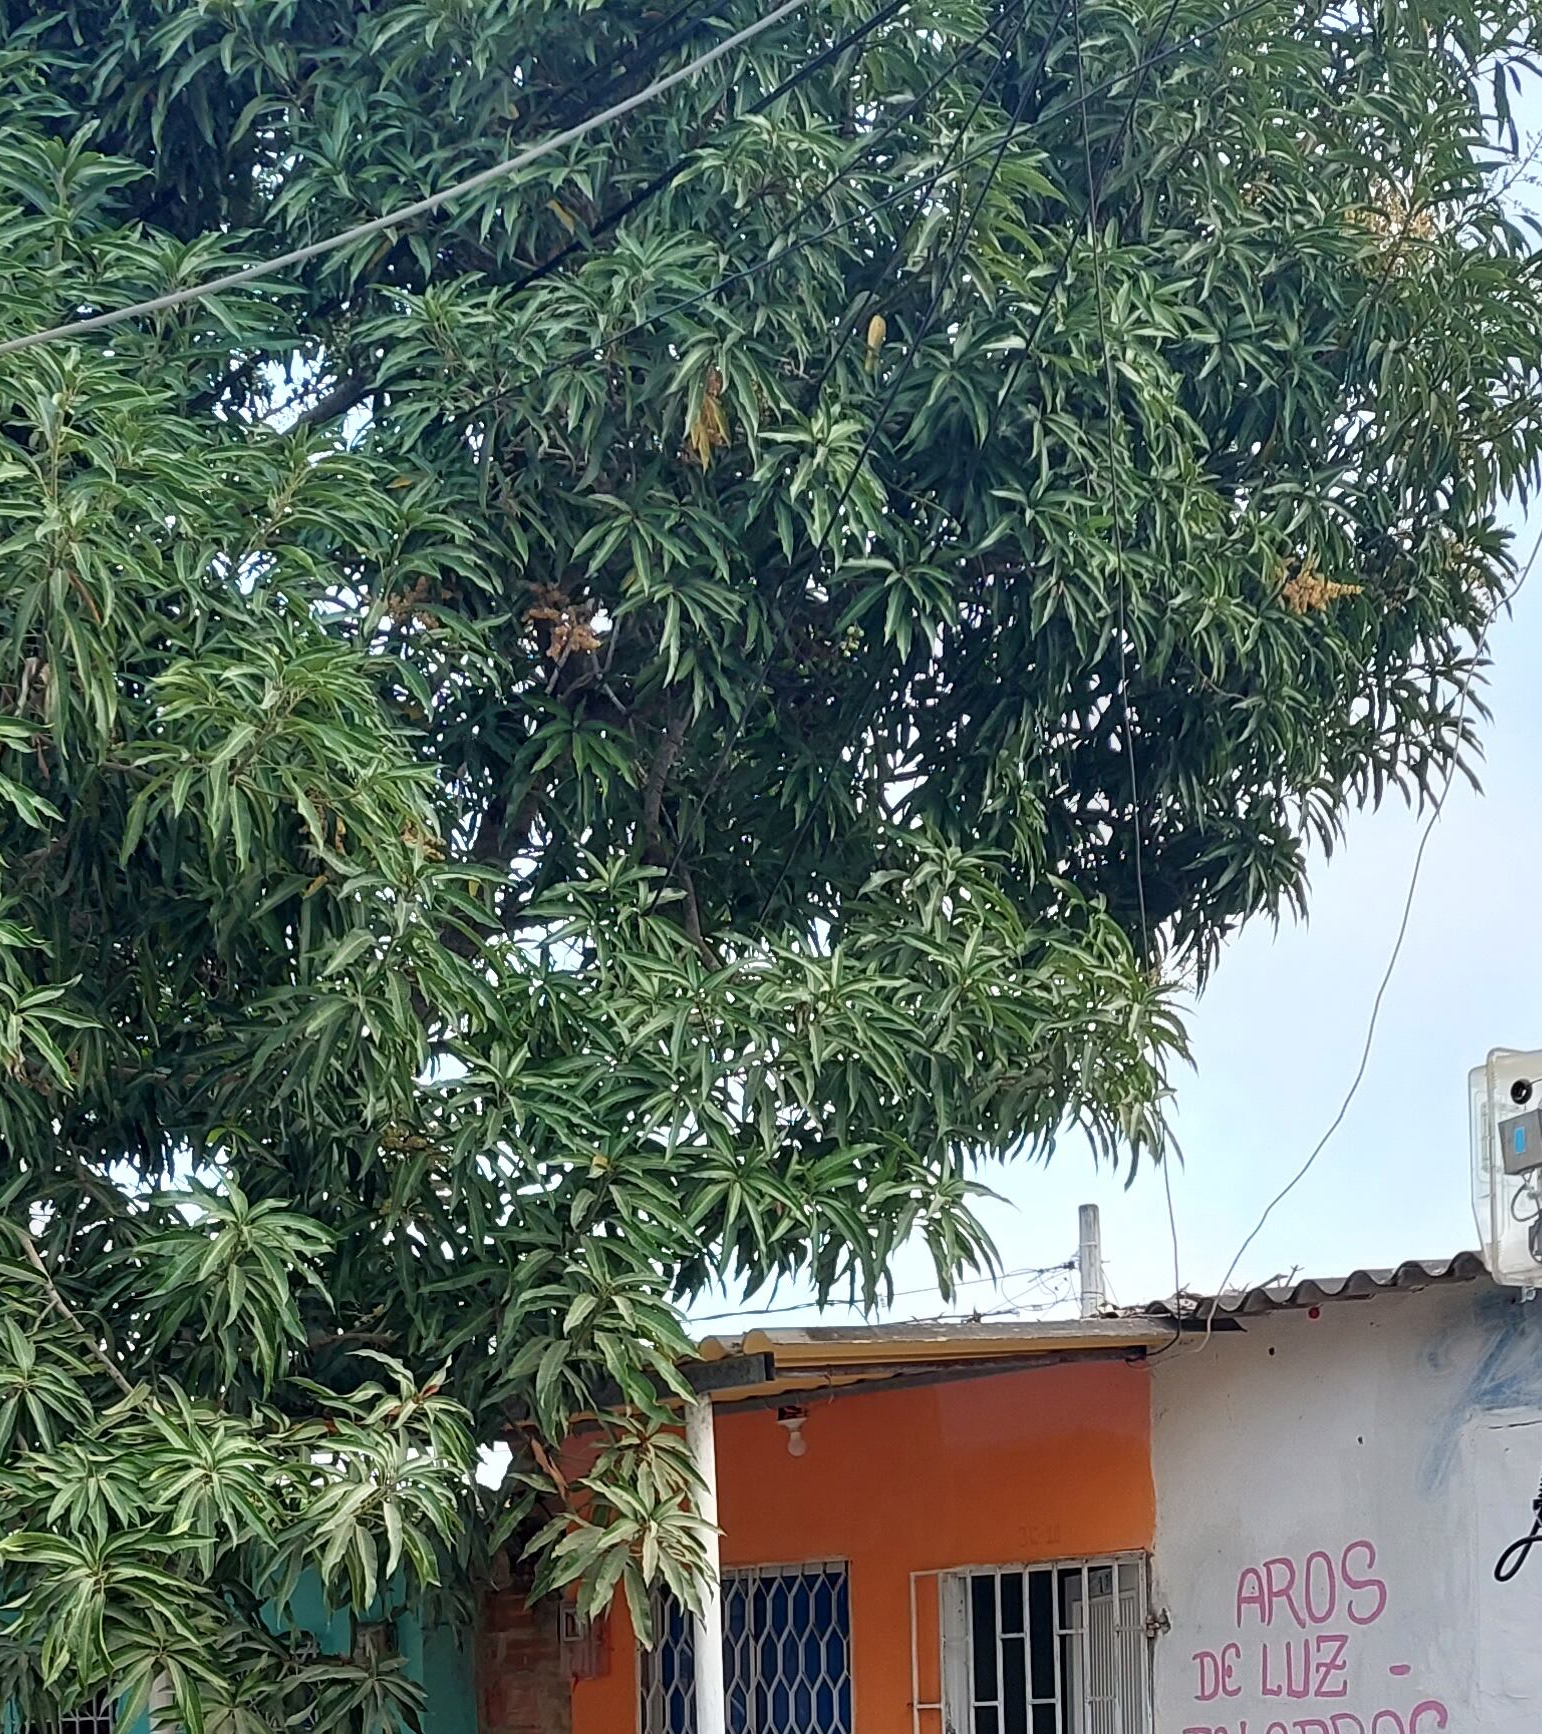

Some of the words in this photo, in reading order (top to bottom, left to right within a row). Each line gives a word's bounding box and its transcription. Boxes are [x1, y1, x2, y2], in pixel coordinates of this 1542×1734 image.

[1236, 1539, 1388, 1629] AROS
[1191, 1642, 1242, 1701] DE
[1260, 1634, 1349, 1699] LUZ
